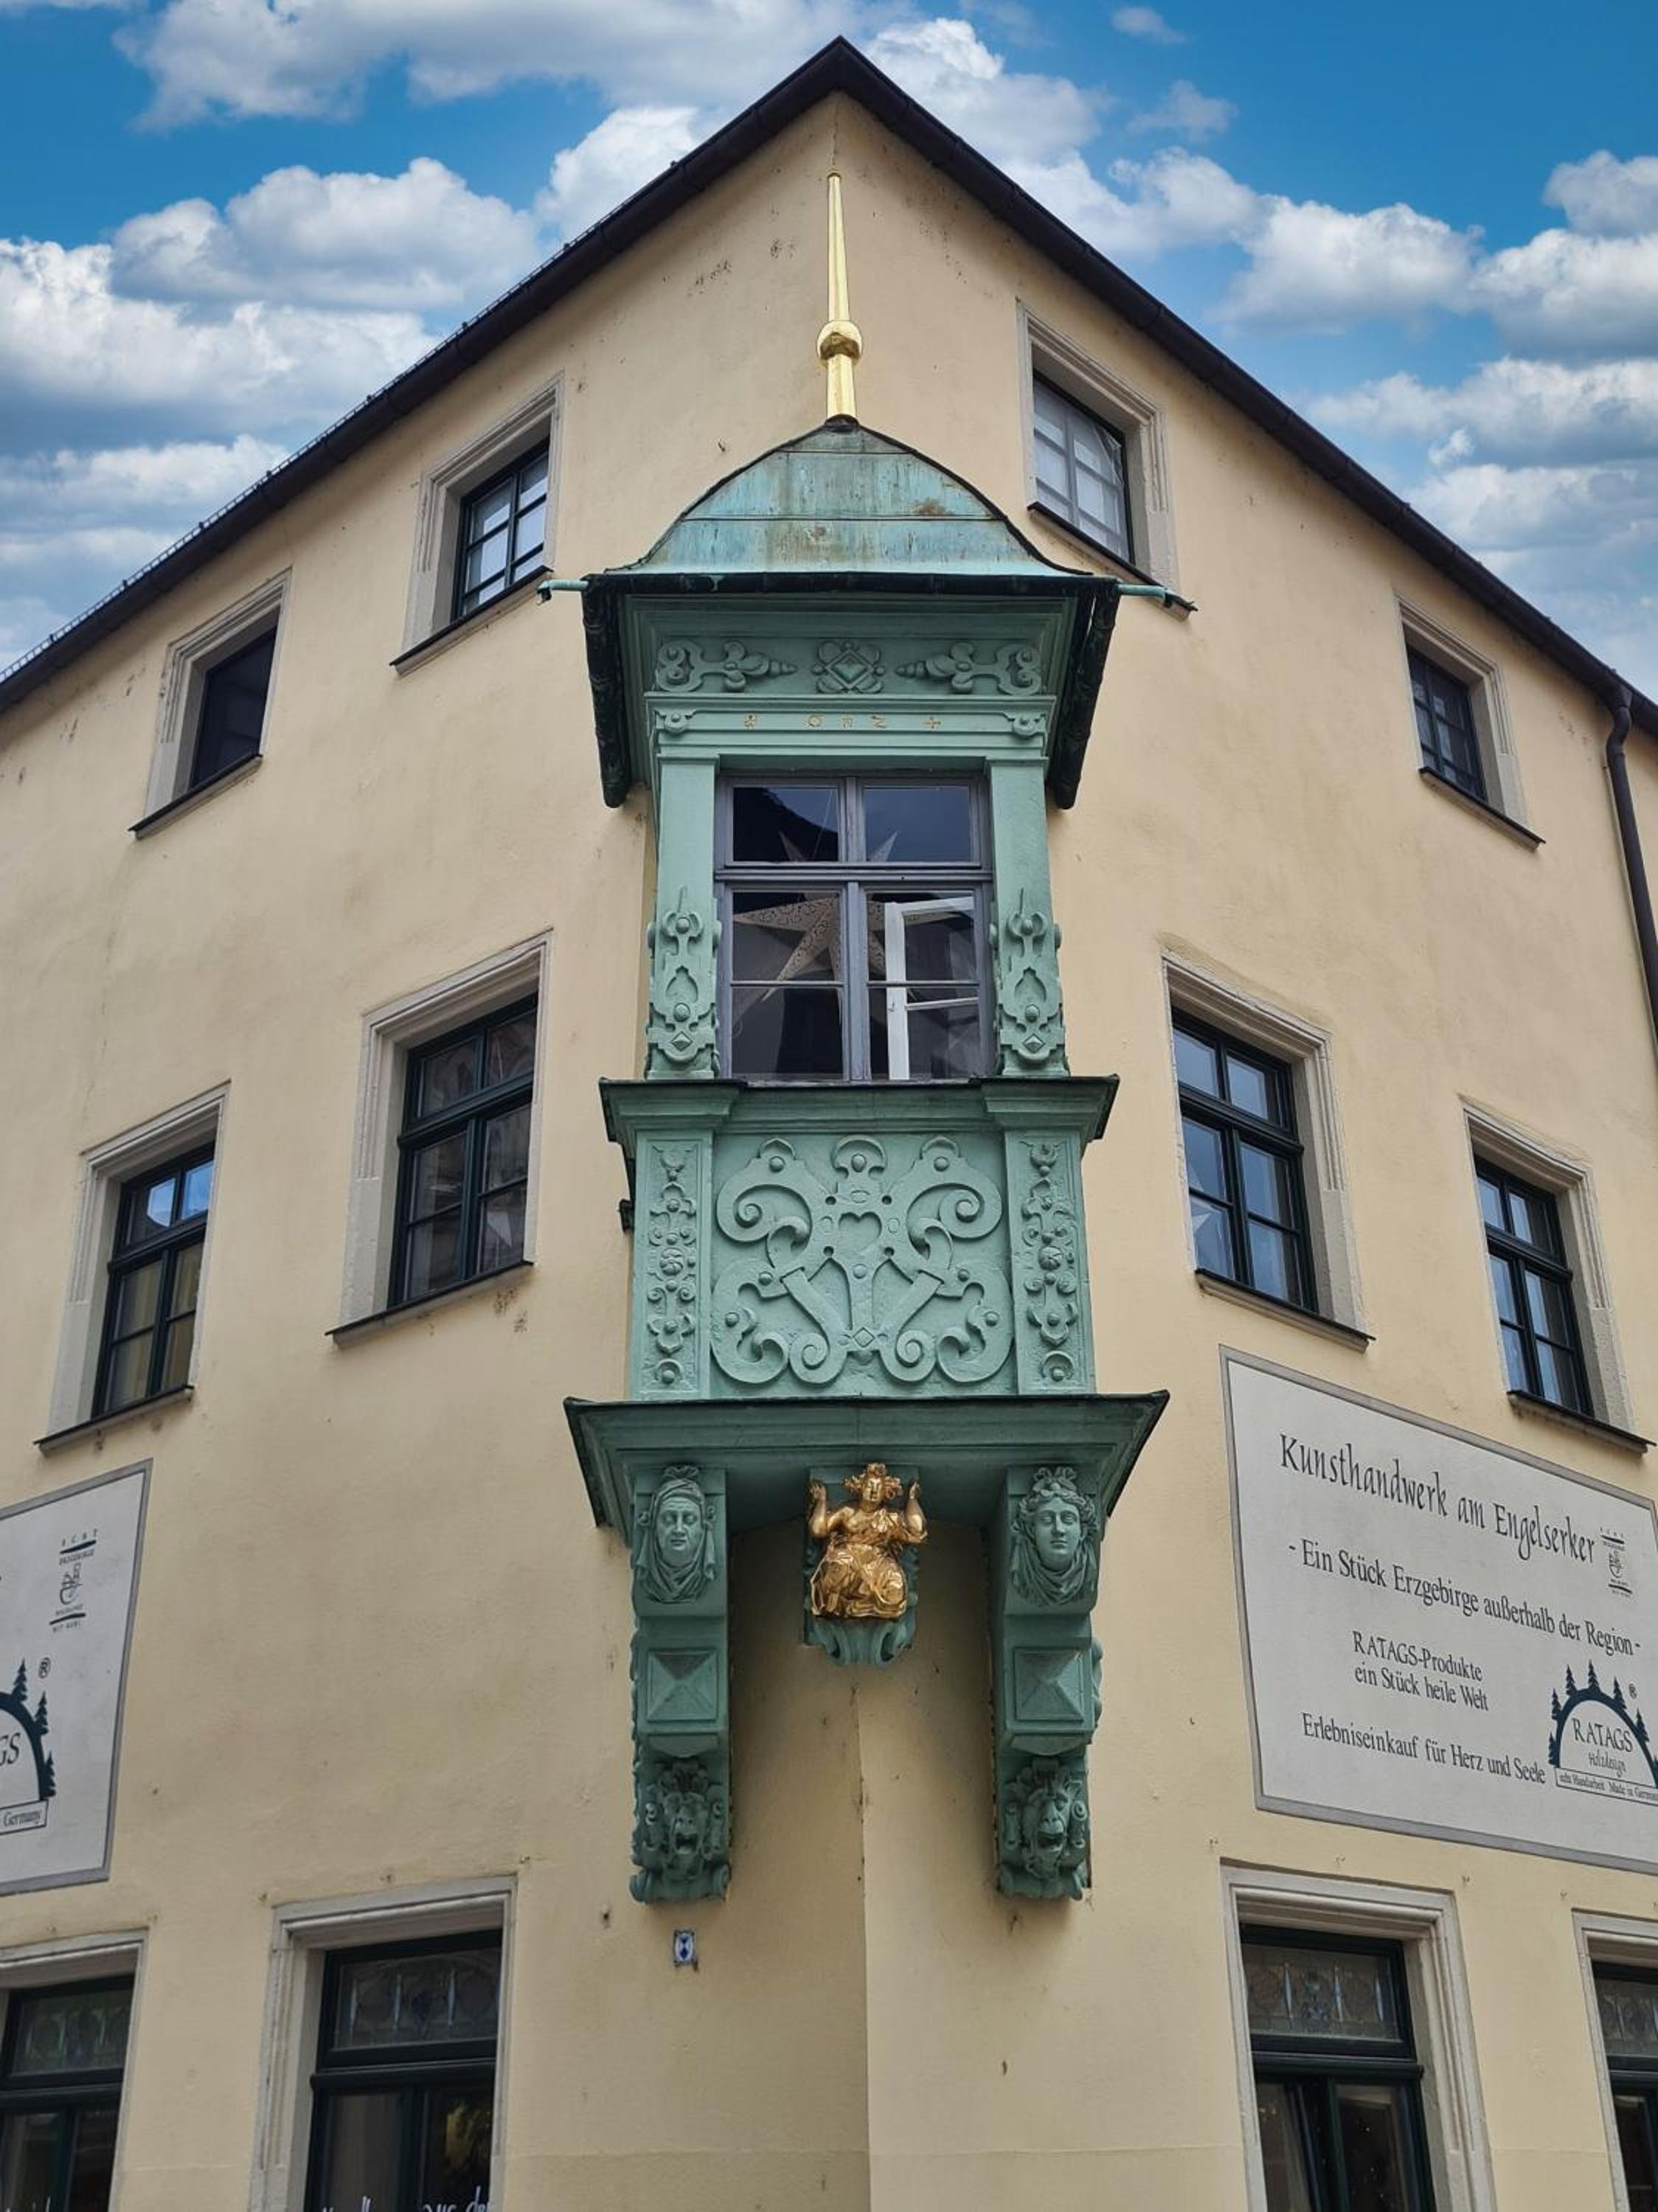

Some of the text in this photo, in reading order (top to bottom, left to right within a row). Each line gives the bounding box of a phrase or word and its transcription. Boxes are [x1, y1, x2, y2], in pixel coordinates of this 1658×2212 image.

[1280, 1433, 1595, 1562] Kunsthandwerk am Engelserker
[1301, 1538, 1333, 1572] Ein
[1339, 1549, 1387, 1587] Stück
[1392, 1565, 1479, 1617] Erzgebirge
[1483, 1595, 1555, 1633] außerhalb
[1559, 1613, 1581, 1641] der
[1353, 1630, 1482, 1682] RATAGS-Produkte
[1355, 1661, 1489, 1711] ein Stück heile Welt
[1302, 1712, 1546, 1784] Erlebniseinkauf für Herz und Seele
[1572, 1717, 1633, 1753] RATAGS
